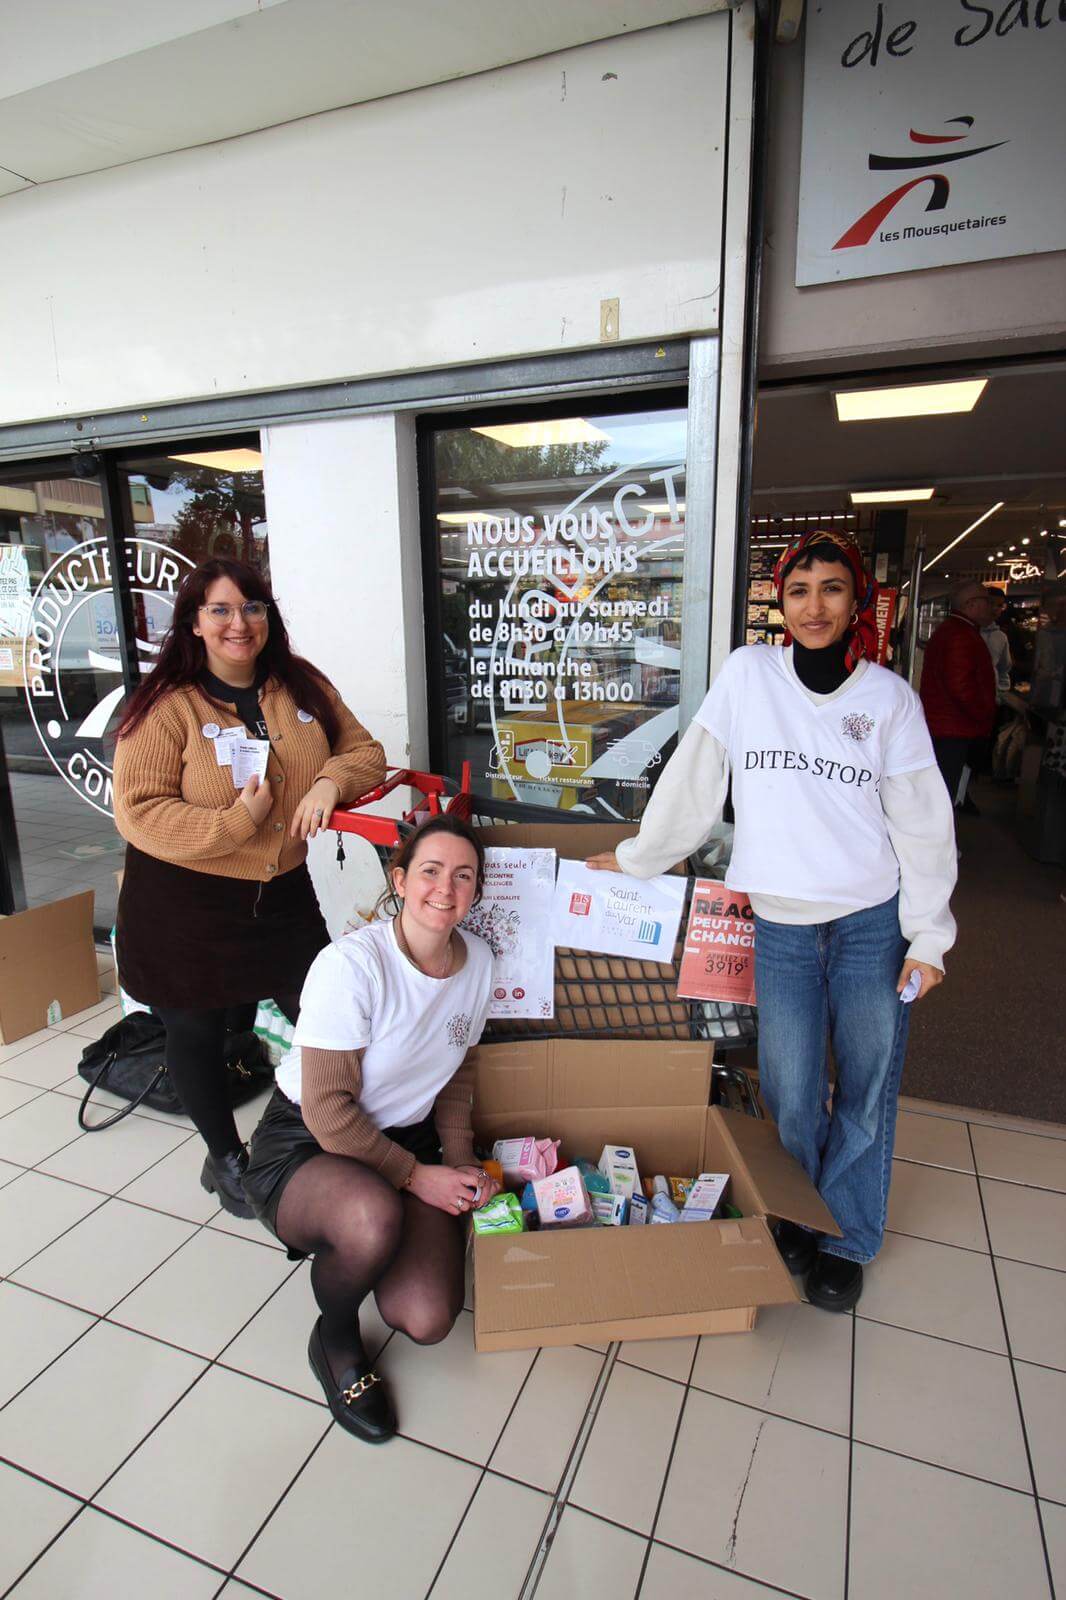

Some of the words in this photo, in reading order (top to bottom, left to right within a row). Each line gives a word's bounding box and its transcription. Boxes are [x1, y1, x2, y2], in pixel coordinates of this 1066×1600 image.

[841, 2, 917, 68] de
[903, 215, 1006, 239] Mousquetaires
[467, 516, 535, 546] NOUS
[543, 511, 614, 543] VOUS
[467, 545, 638, 578] ACCUEILLONS
[468, 599, 493, 618] du
[499, 598, 550, 618] lundi
[556, 601, 582, 617] au
[588, 596, 669, 617] samedi
[30, 547, 189, 697] PRODUCTEUR
[468, 622, 492, 643] de
[498, 624, 547, 642] 8h30
[572, 622, 633, 642] 19h45
[471, 657, 487, 676] le
[493, 657, 592, 677] dimanche
[471, 680, 493, 698] de
[500, 681, 547, 699] 8h30
[572, 682, 634, 702] 13h00
[744, 750, 809, 771] DITES
[621, 781, 651, 790] domicile
[484, 862, 500, 872] pas
[504, 860, 527, 869] seule
[692, 916, 733, 930] PEUT
[705, 960, 744, 975] 3919
